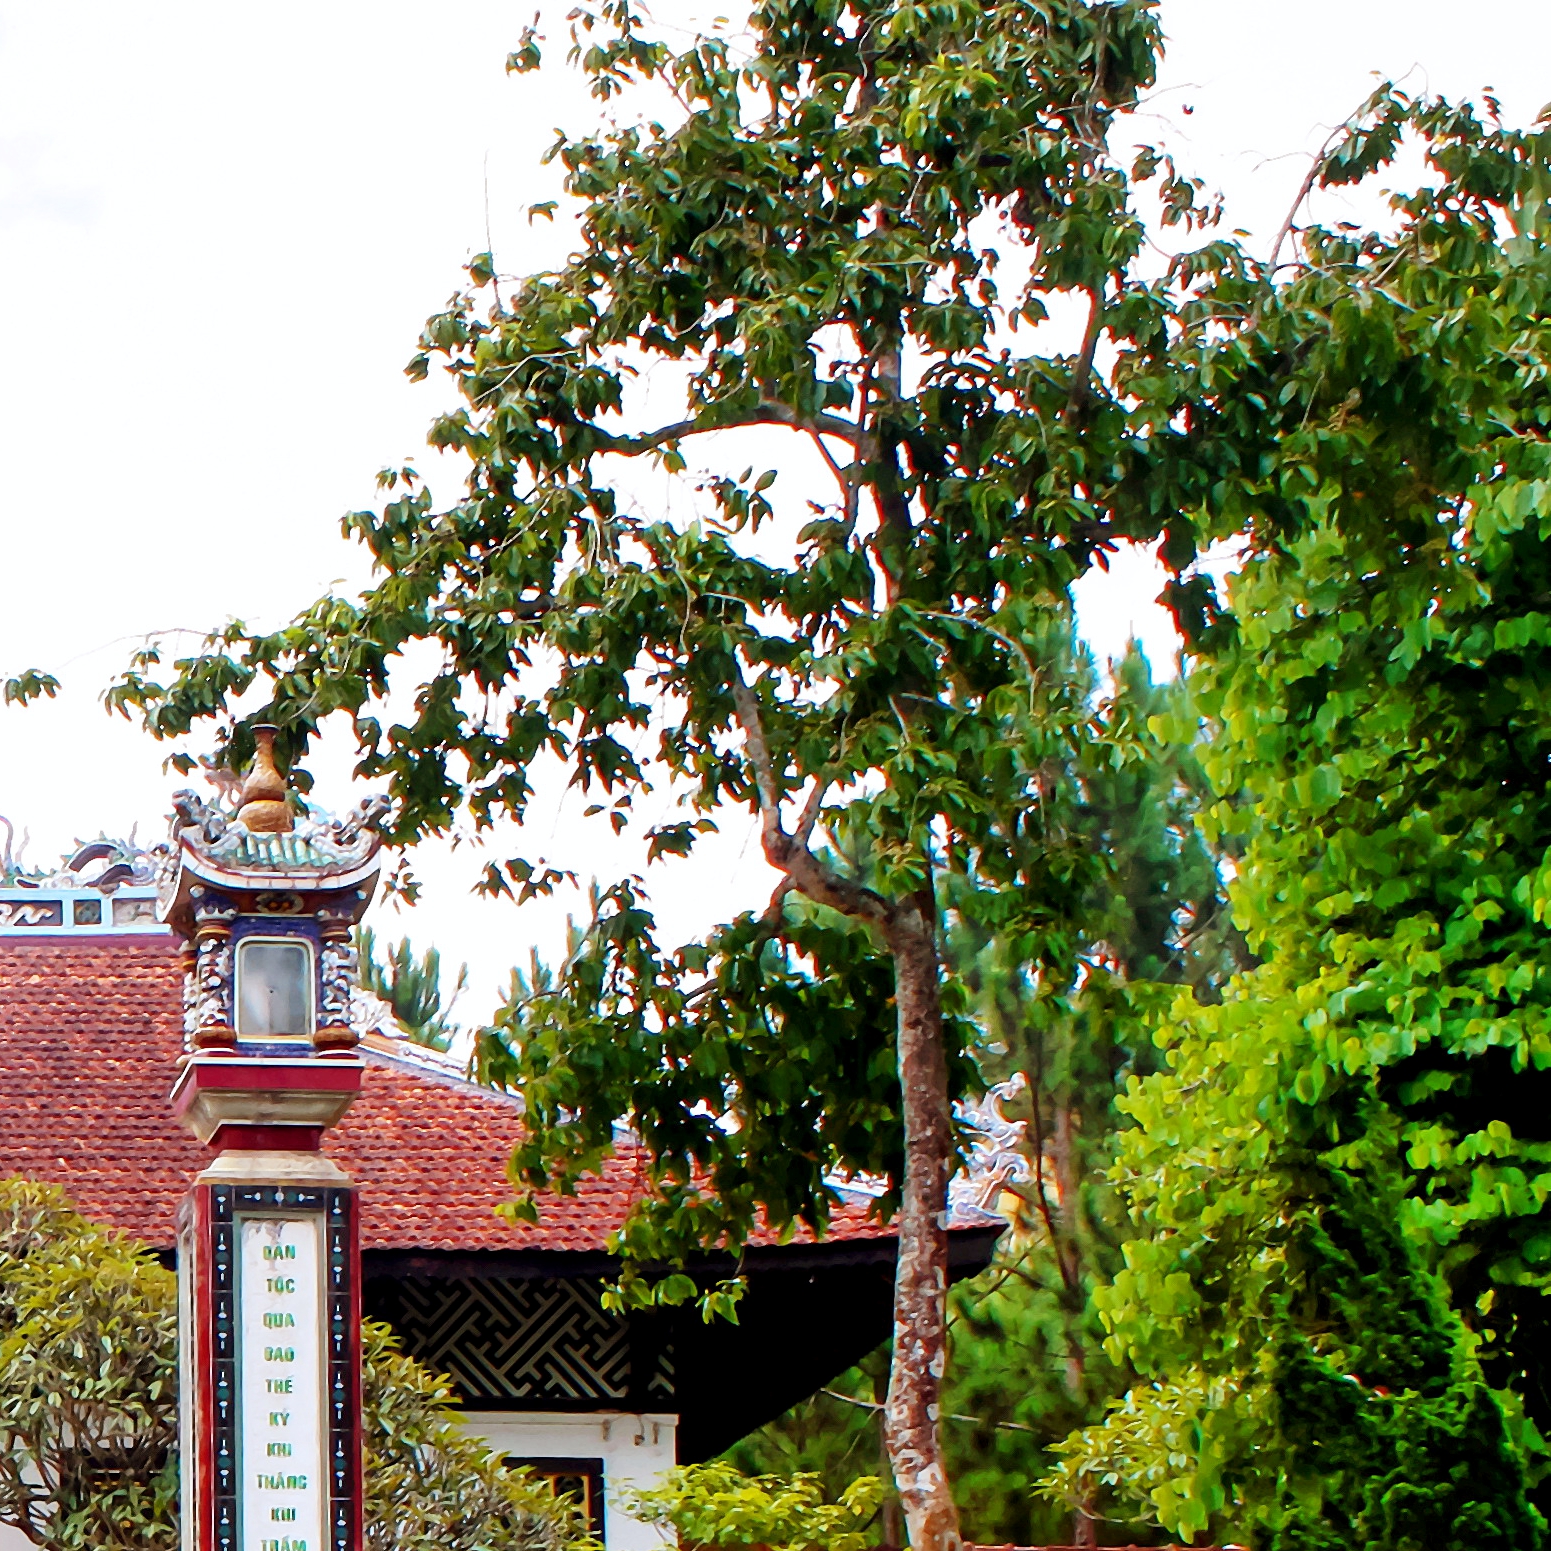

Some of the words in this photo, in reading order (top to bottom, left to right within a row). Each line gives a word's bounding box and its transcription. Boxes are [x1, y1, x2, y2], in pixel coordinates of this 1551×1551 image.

[262, 1312, 296, 1330] QUA
[266, 1442, 292, 1457] KHI
[271, 1507, 296, 1522] KHI
